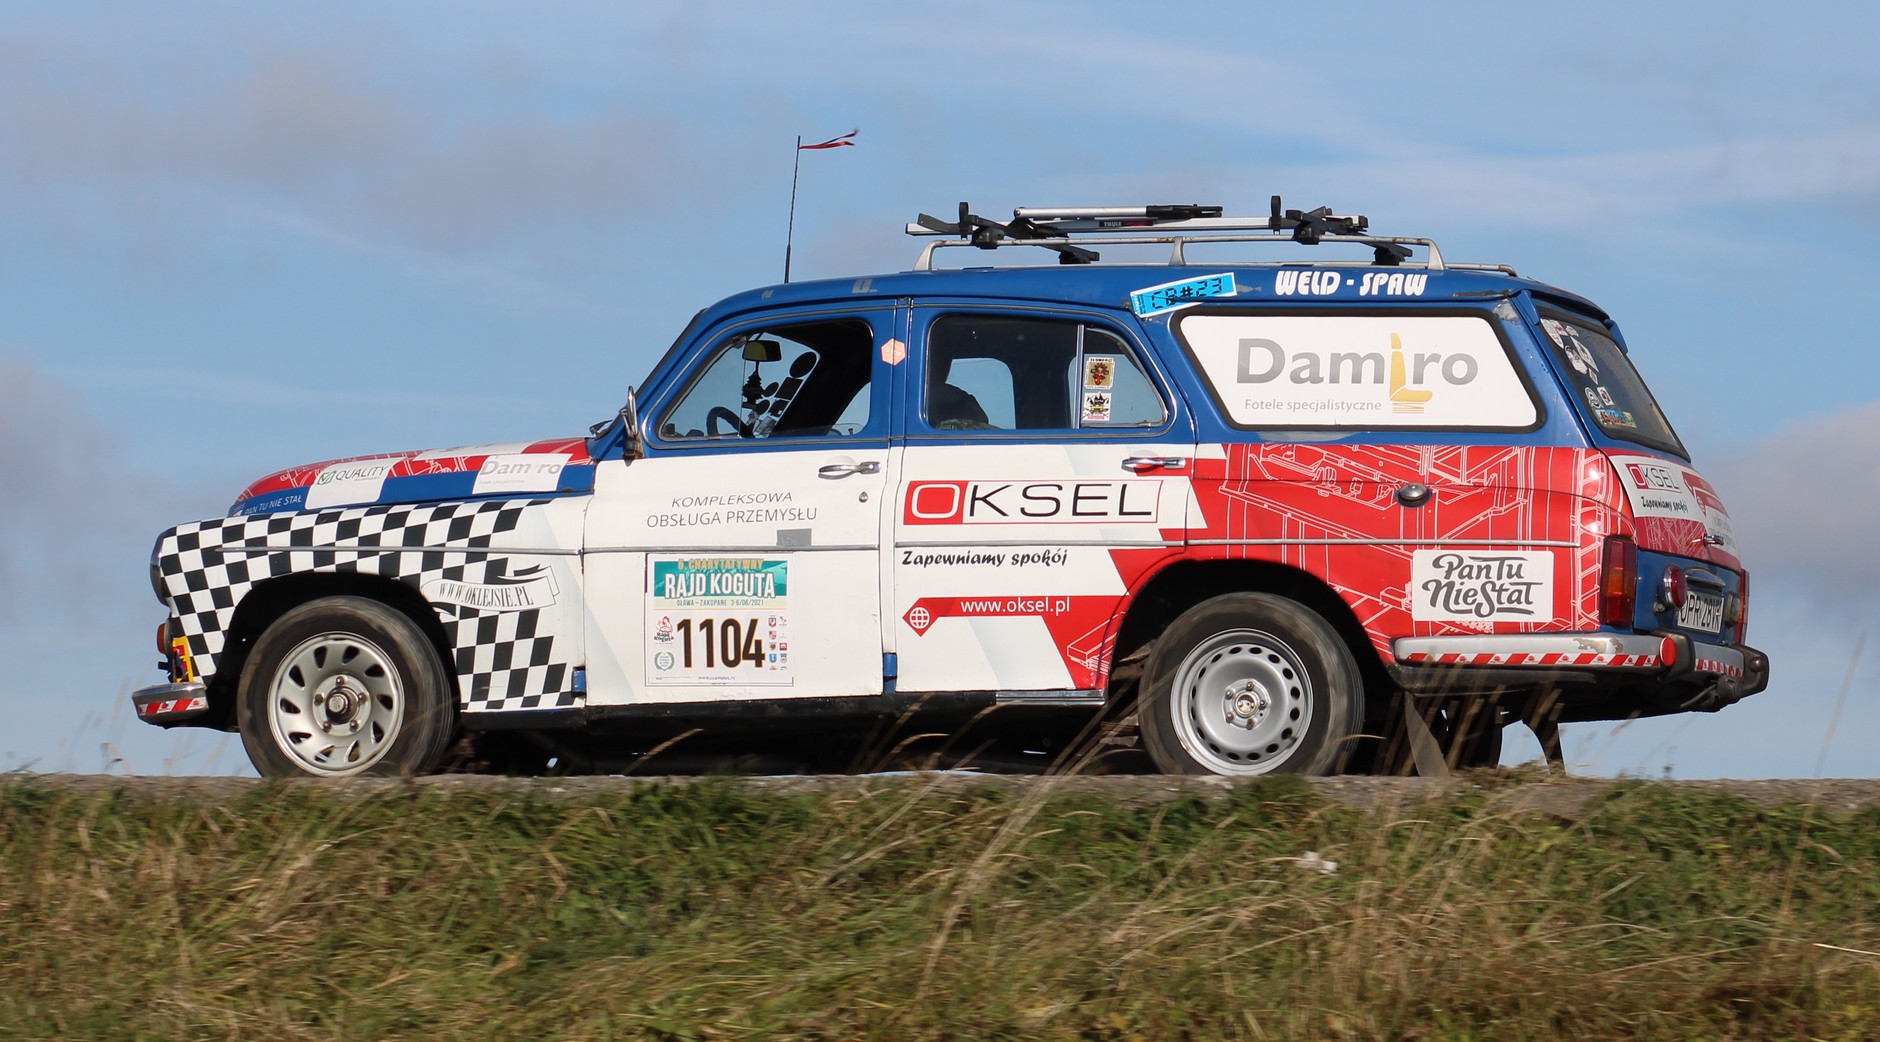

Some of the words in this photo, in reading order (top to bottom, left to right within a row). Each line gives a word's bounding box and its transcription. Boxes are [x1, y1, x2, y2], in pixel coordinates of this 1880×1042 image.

[1151, 278, 1222, 309] CB#23
[1275, 270, 1340, 296] WELD
[1359, 272, 1428, 296] SPAW
[1236, 333, 1479, 398] Damiro
[1244, 399, 1284, 411] Fotele
[1287, 399, 1382, 413] specjalistyczne
[336, 465, 390, 481] QUALITY
[1629, 466, 1680, 490] OKSEL
[259, 502, 269, 511] TU
[269, 498, 283, 508] NIE
[671, 492, 793, 508] KOMPLEKSOWA
[911, 483, 1153, 519] OKSEL
[646, 512, 721, 528] OBSŁUGA
[726, 507, 818, 524] PRZEMYSŁU
[688, 558, 765, 570] CHARYTATYWNY
[902, 550, 1006, 568] Zapewniamy
[1011, 548, 1068, 567] spokój
[438, 582, 535, 607] WWW.OKLEJSIE.PL
[664, 572, 707, 599] RAJD
[710, 572, 776, 598] KOGUTA
[699, 599, 727, 607] ZAKOPANE
[961, 597, 1070, 616] www.oksel.pl
[676, 617, 766, 668] 1104
